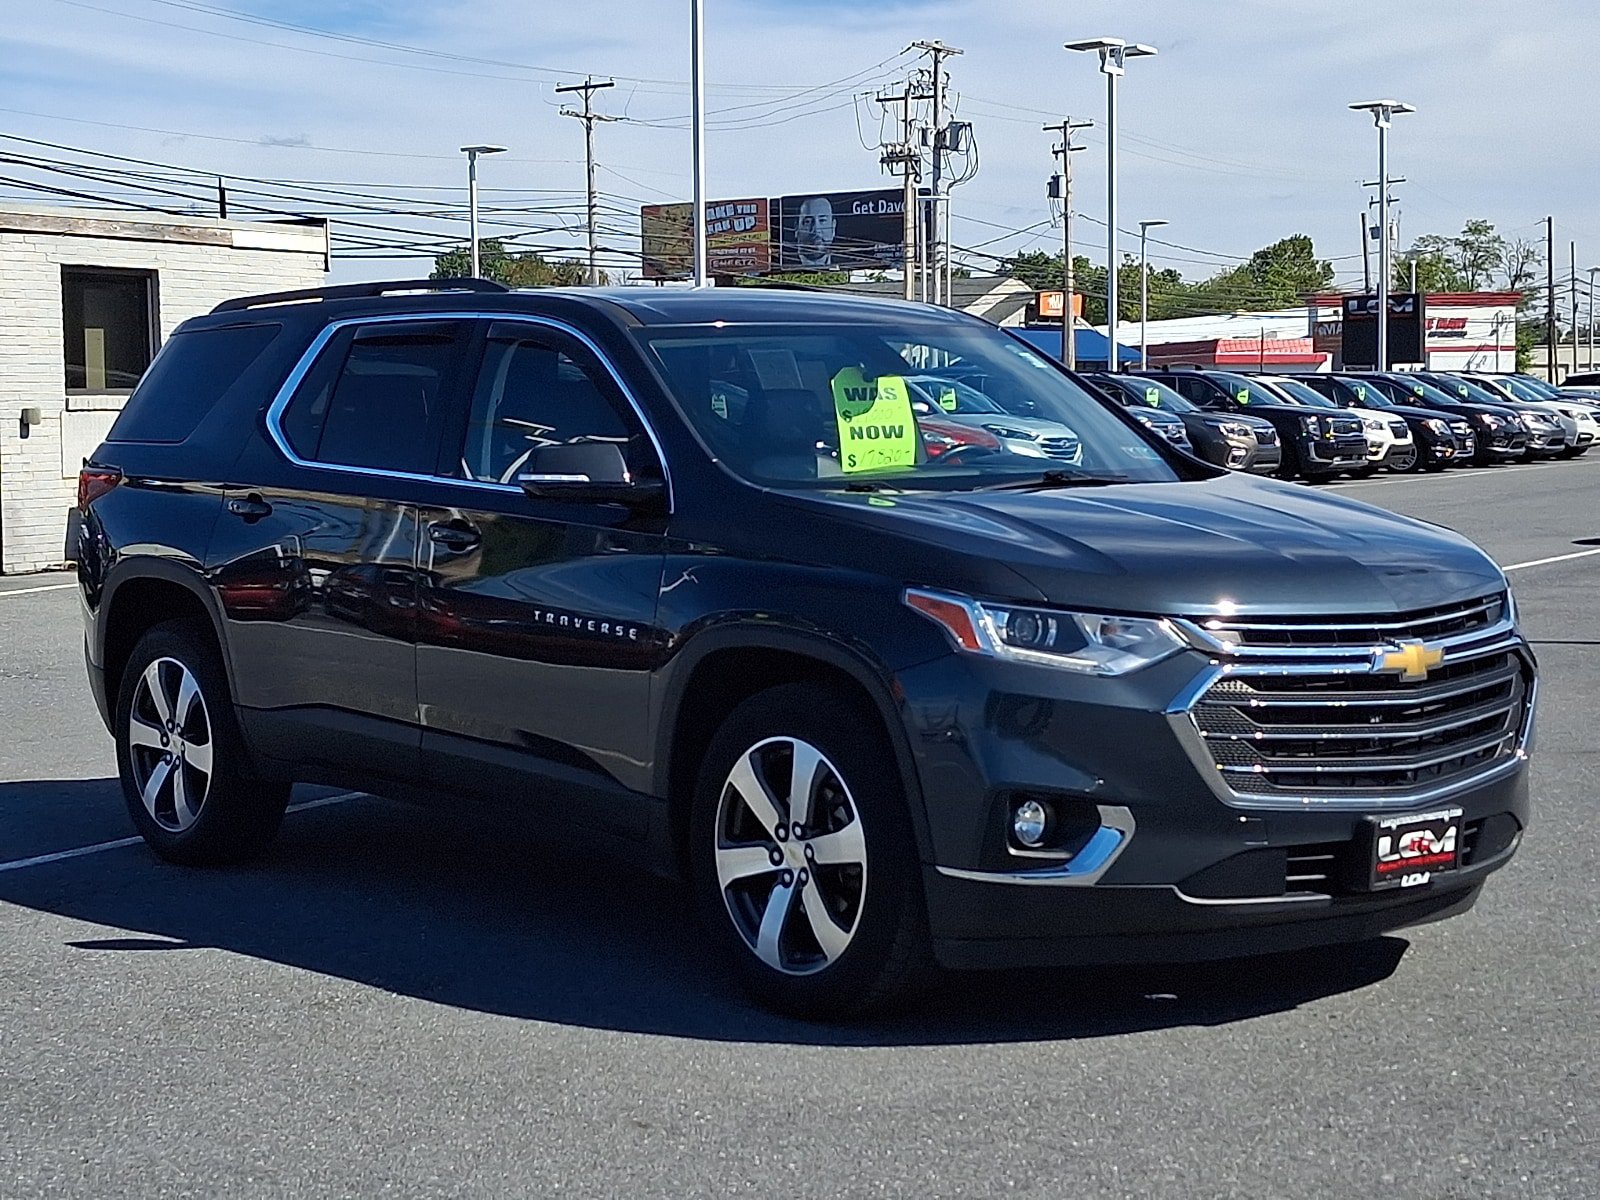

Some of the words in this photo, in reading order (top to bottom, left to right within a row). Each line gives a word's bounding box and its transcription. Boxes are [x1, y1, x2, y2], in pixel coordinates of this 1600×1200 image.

[852, 201, 875, 215] Get
[733, 216, 756, 232] UP
[843, 386, 897, 401] WAS
[849, 425, 904, 440] NOW
[847, 453, 857, 467] $
[534, 610, 637, 640] TRAVERSE
